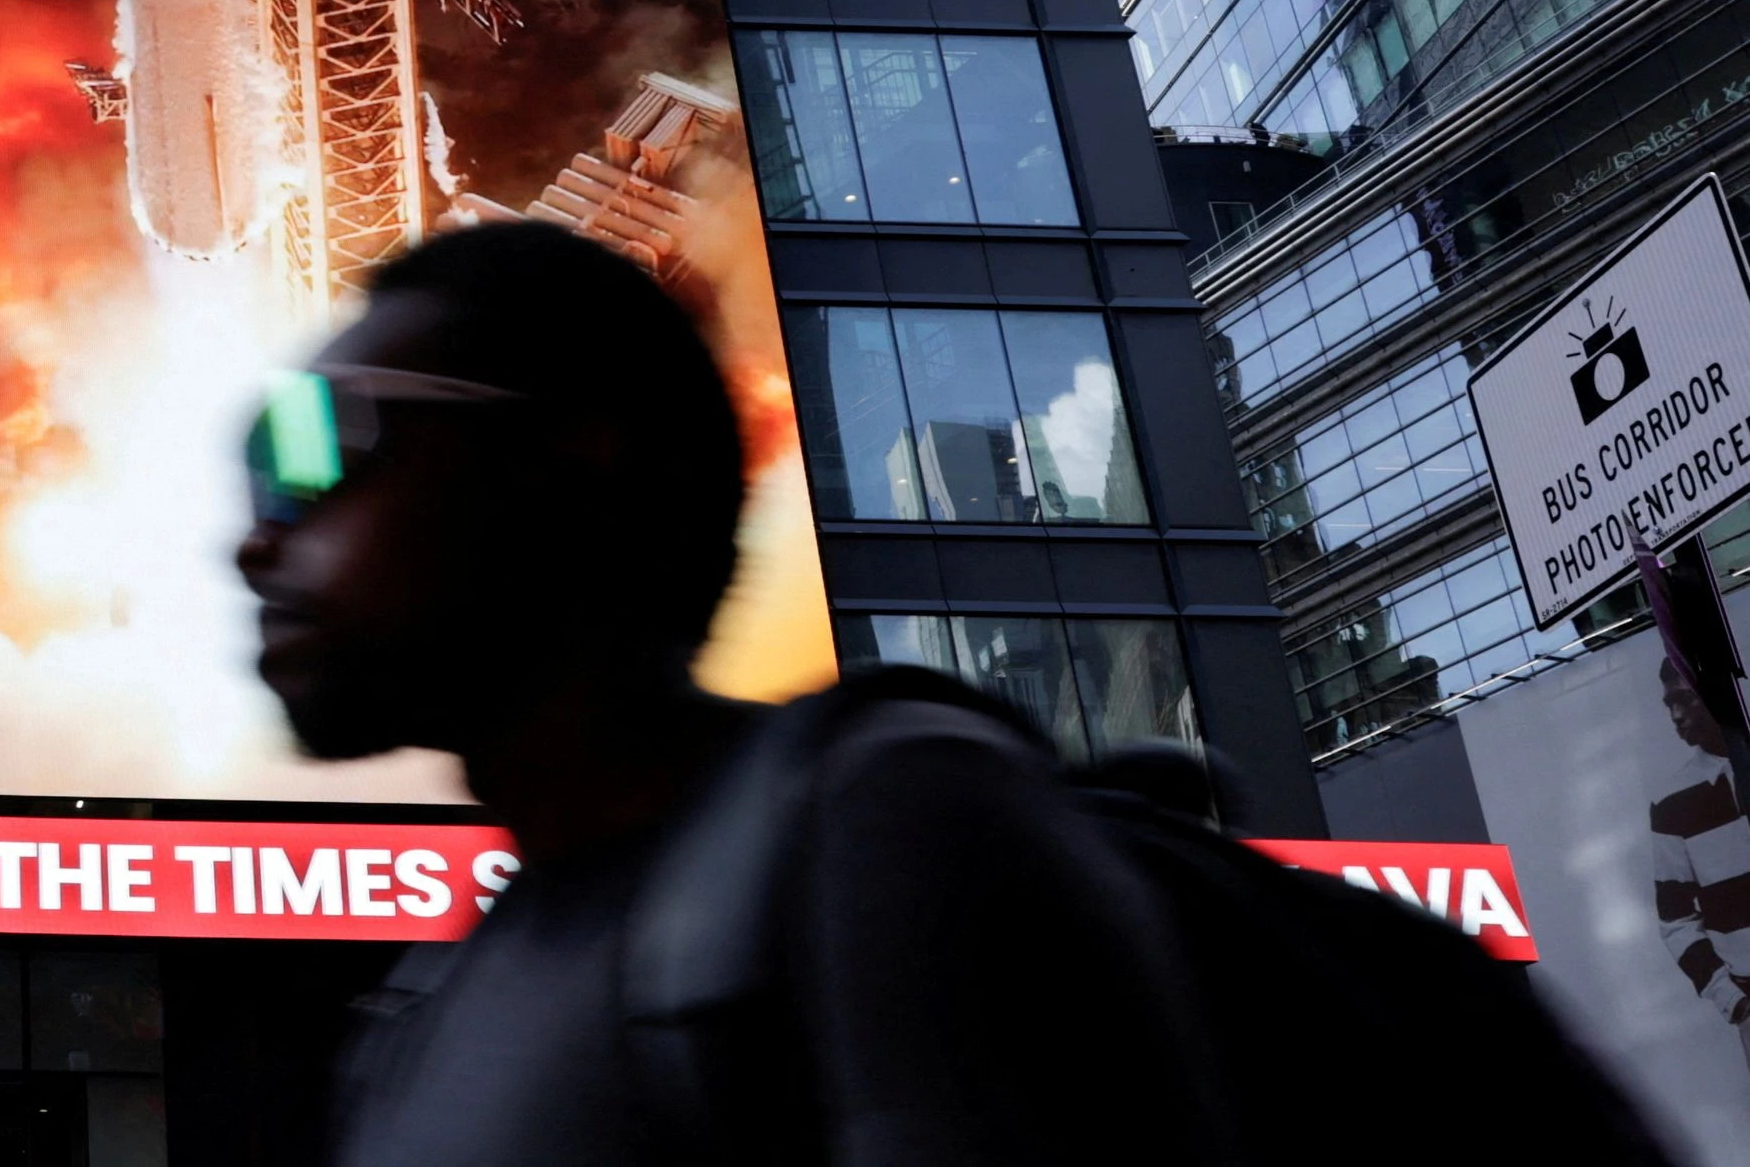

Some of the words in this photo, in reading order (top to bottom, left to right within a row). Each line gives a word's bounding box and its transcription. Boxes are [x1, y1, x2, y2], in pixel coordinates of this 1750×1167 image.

[1542, 462, 1593, 525] BUS
[1598, 361, 1731, 483] CORRIDOR
[1544, 514, 1625, 595] PHOTO
[1627, 414, 1750, 536] ENFORCE
[173, 845, 452, 918] TIMES
